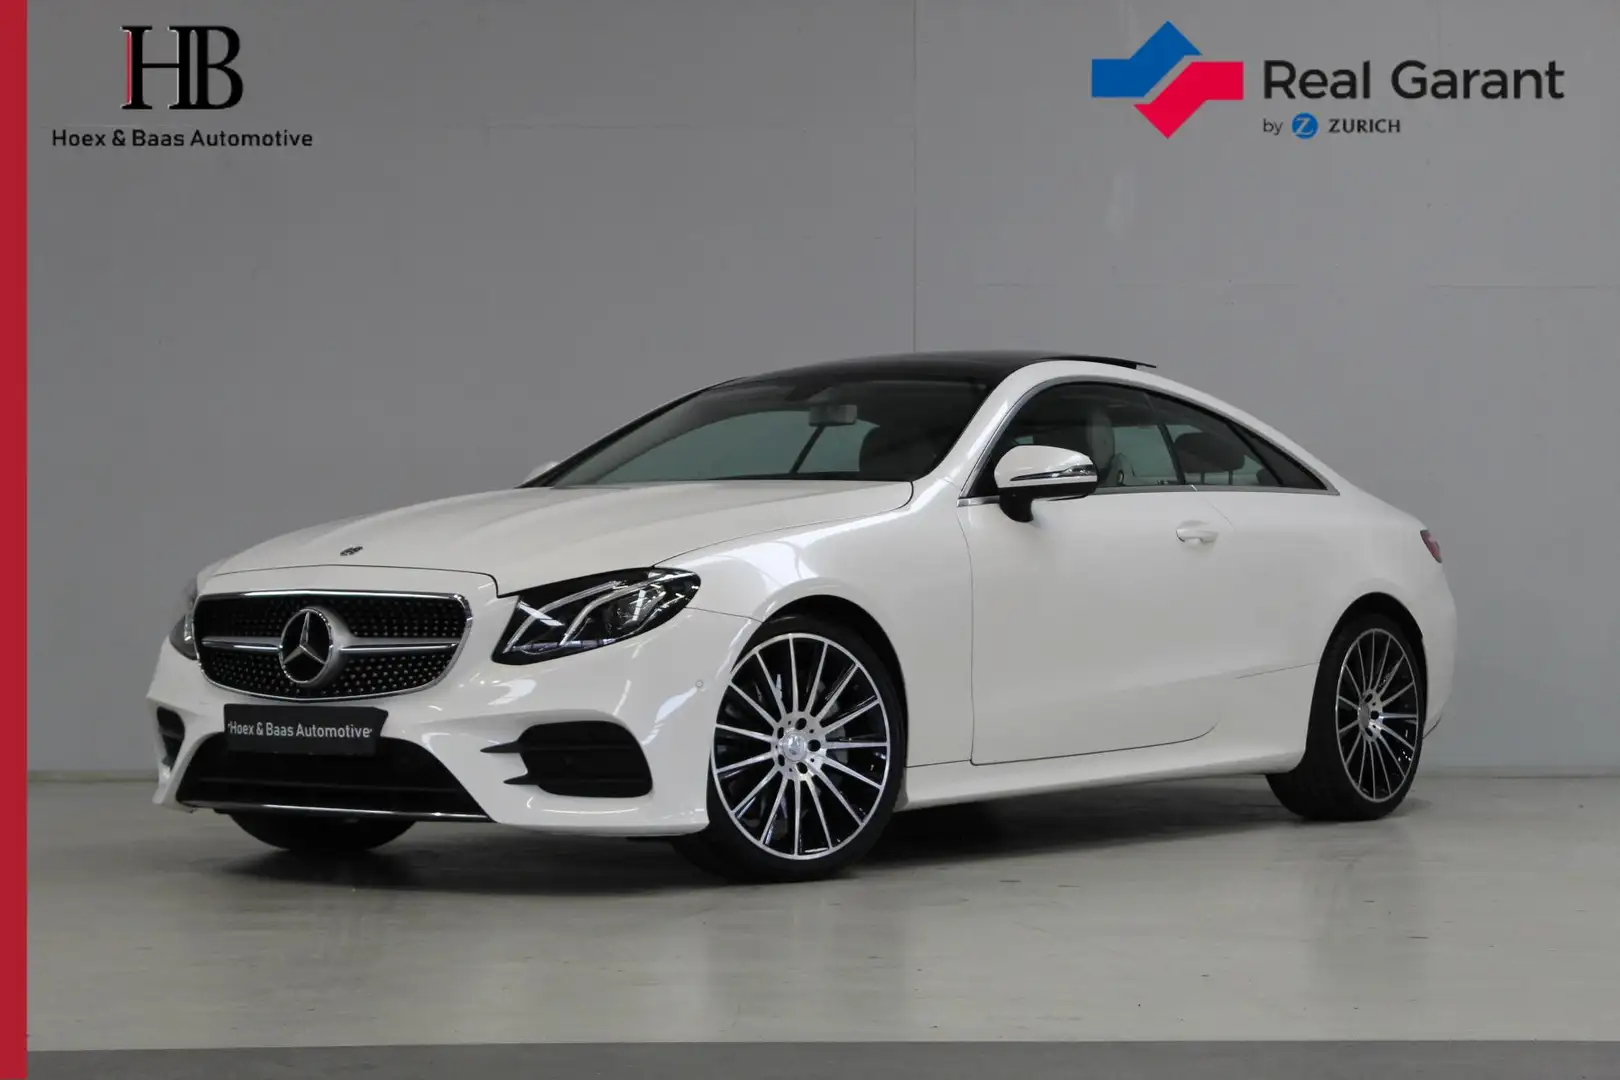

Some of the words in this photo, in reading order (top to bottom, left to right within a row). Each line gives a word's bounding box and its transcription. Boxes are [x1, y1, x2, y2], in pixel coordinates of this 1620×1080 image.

[229, 720, 255, 735] Hoex
[256, 722, 264, 736] &
[266, 722, 294, 737] Baas
[296, 723, 371, 738] Automotive
